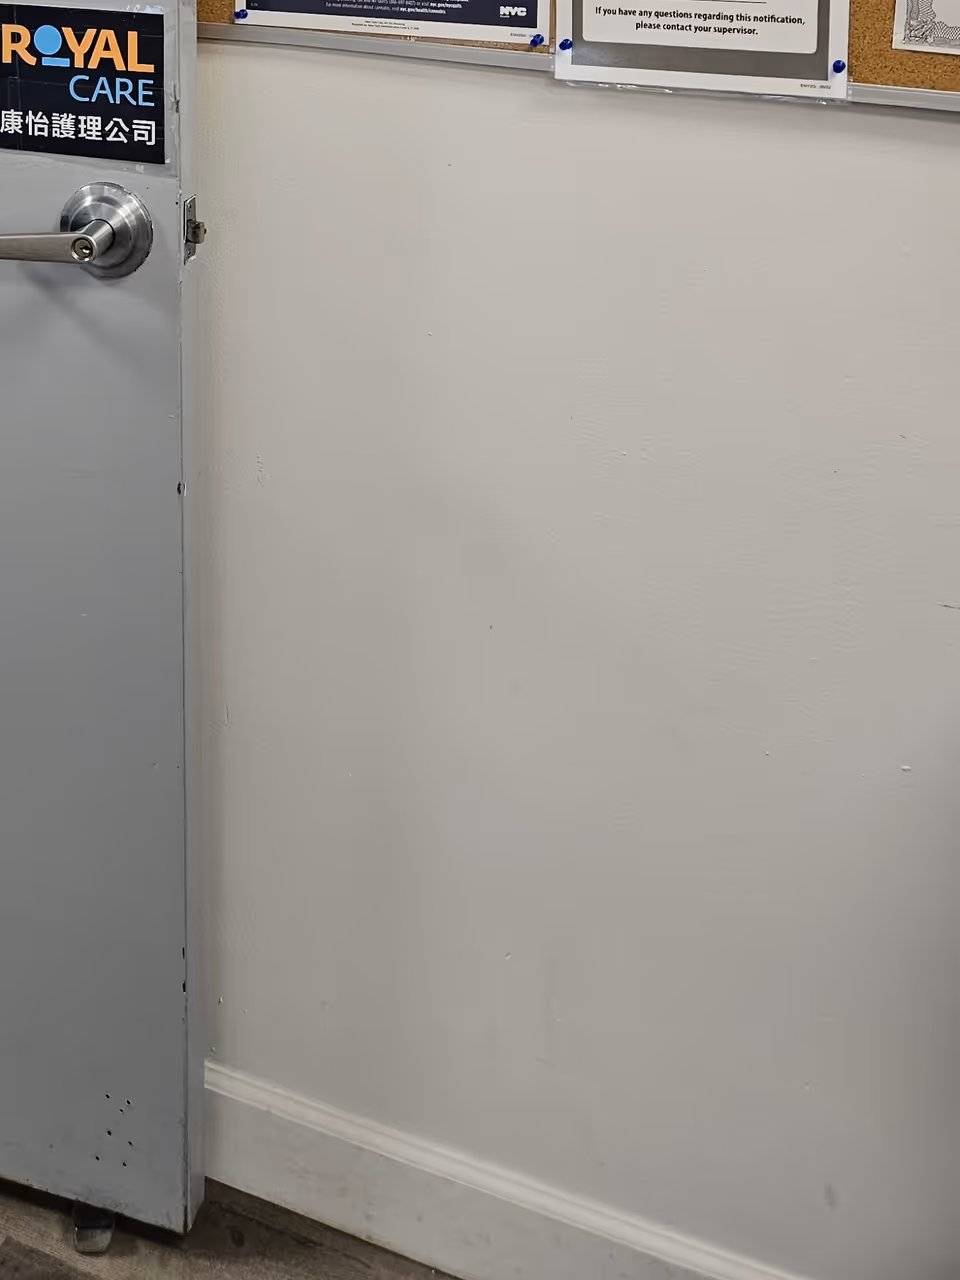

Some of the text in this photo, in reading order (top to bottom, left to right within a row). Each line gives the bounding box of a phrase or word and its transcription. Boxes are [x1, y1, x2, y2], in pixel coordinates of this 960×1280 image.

[636, 21, 661, 30] please
[714, 26, 758, 35] supervisor.
[2, 24, 154, 73] ROYAL
[69, 75, 155, 106] CARE
[0, 109, 155, 145] 康怡護理公司
